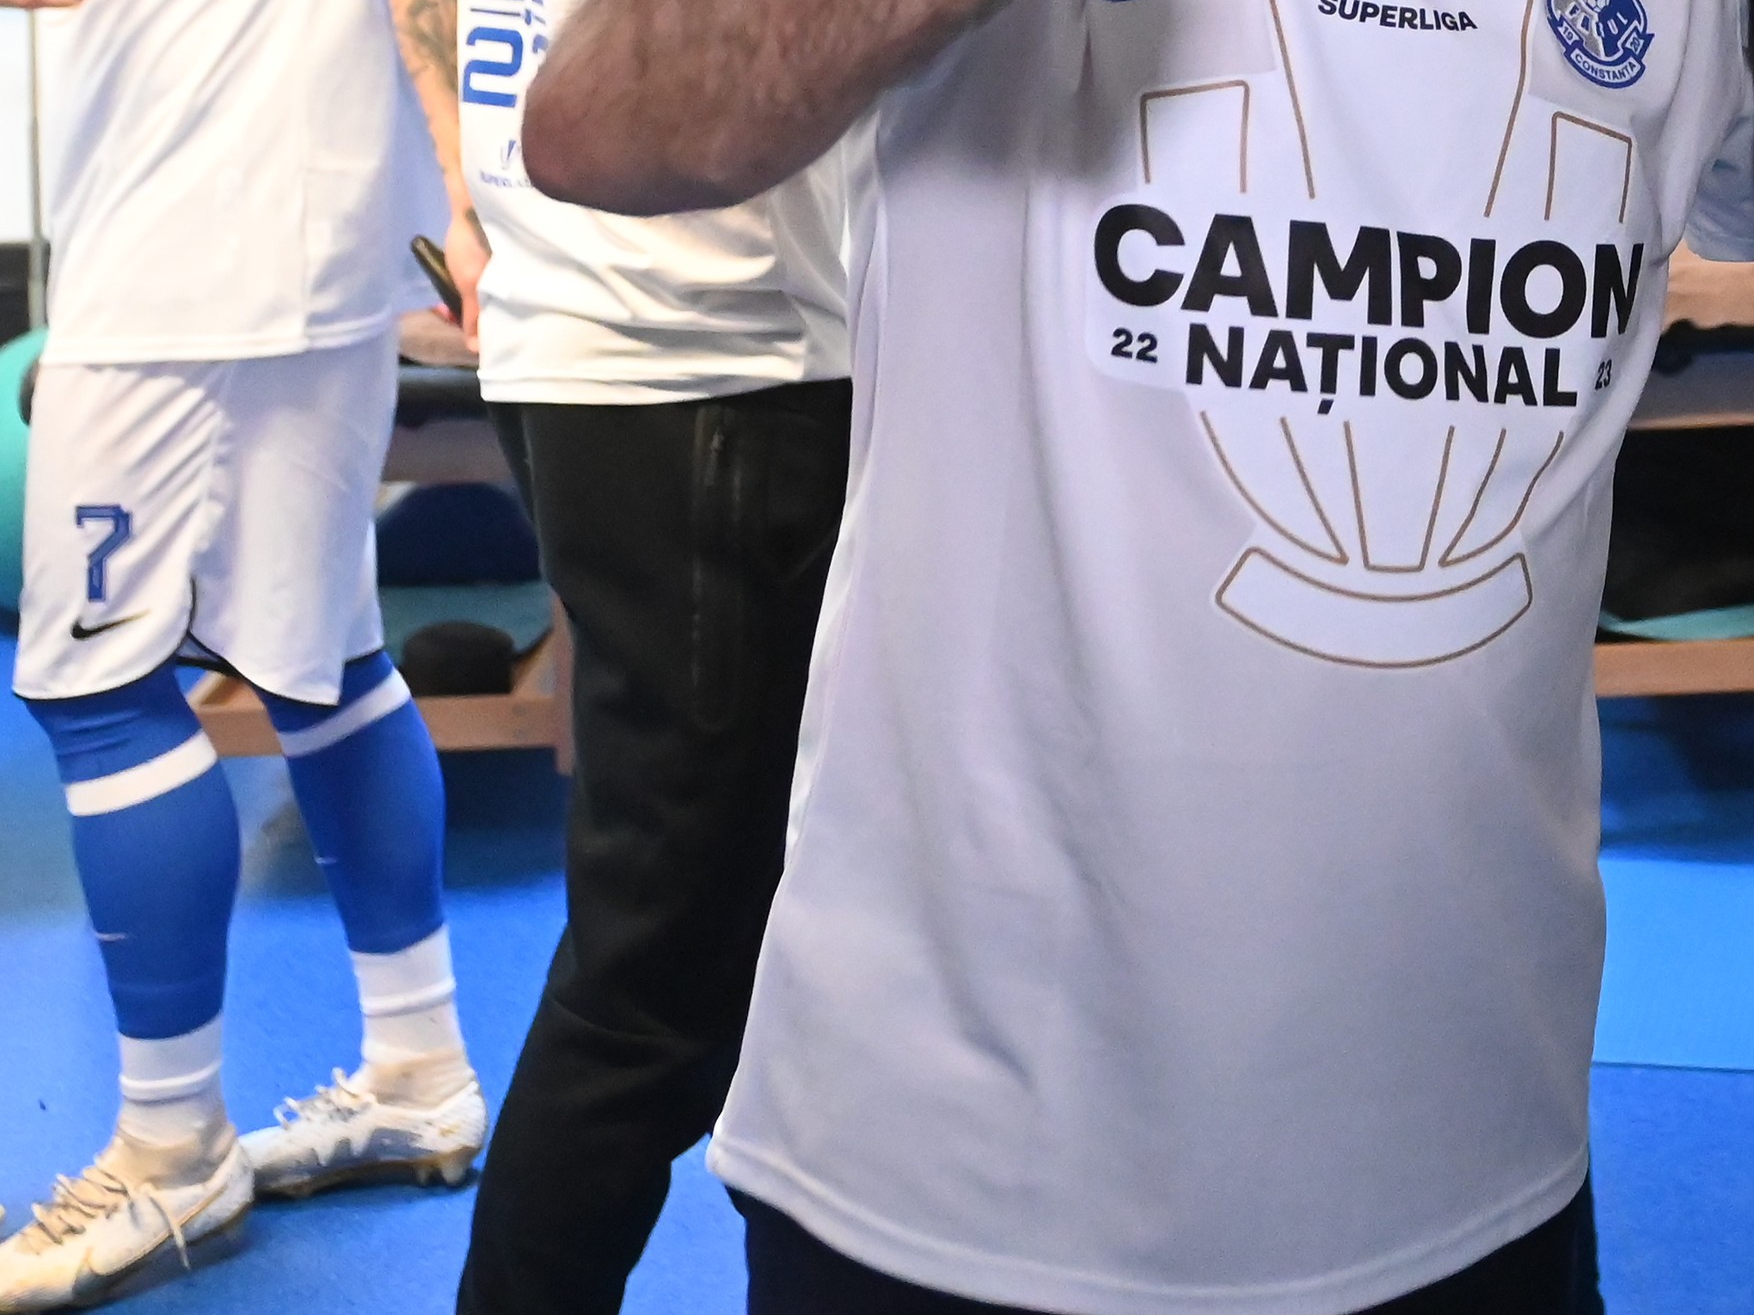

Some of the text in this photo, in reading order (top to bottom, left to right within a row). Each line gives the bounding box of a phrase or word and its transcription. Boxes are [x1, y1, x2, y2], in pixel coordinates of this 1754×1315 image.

[1567, 3, 1630, 39] FARUL
[1093, 203, 1645, 340] CAMPION
[1111, 322, 1612, 415] 22 NAȚIONAL 23
[75, 504, 133, 603] 7
